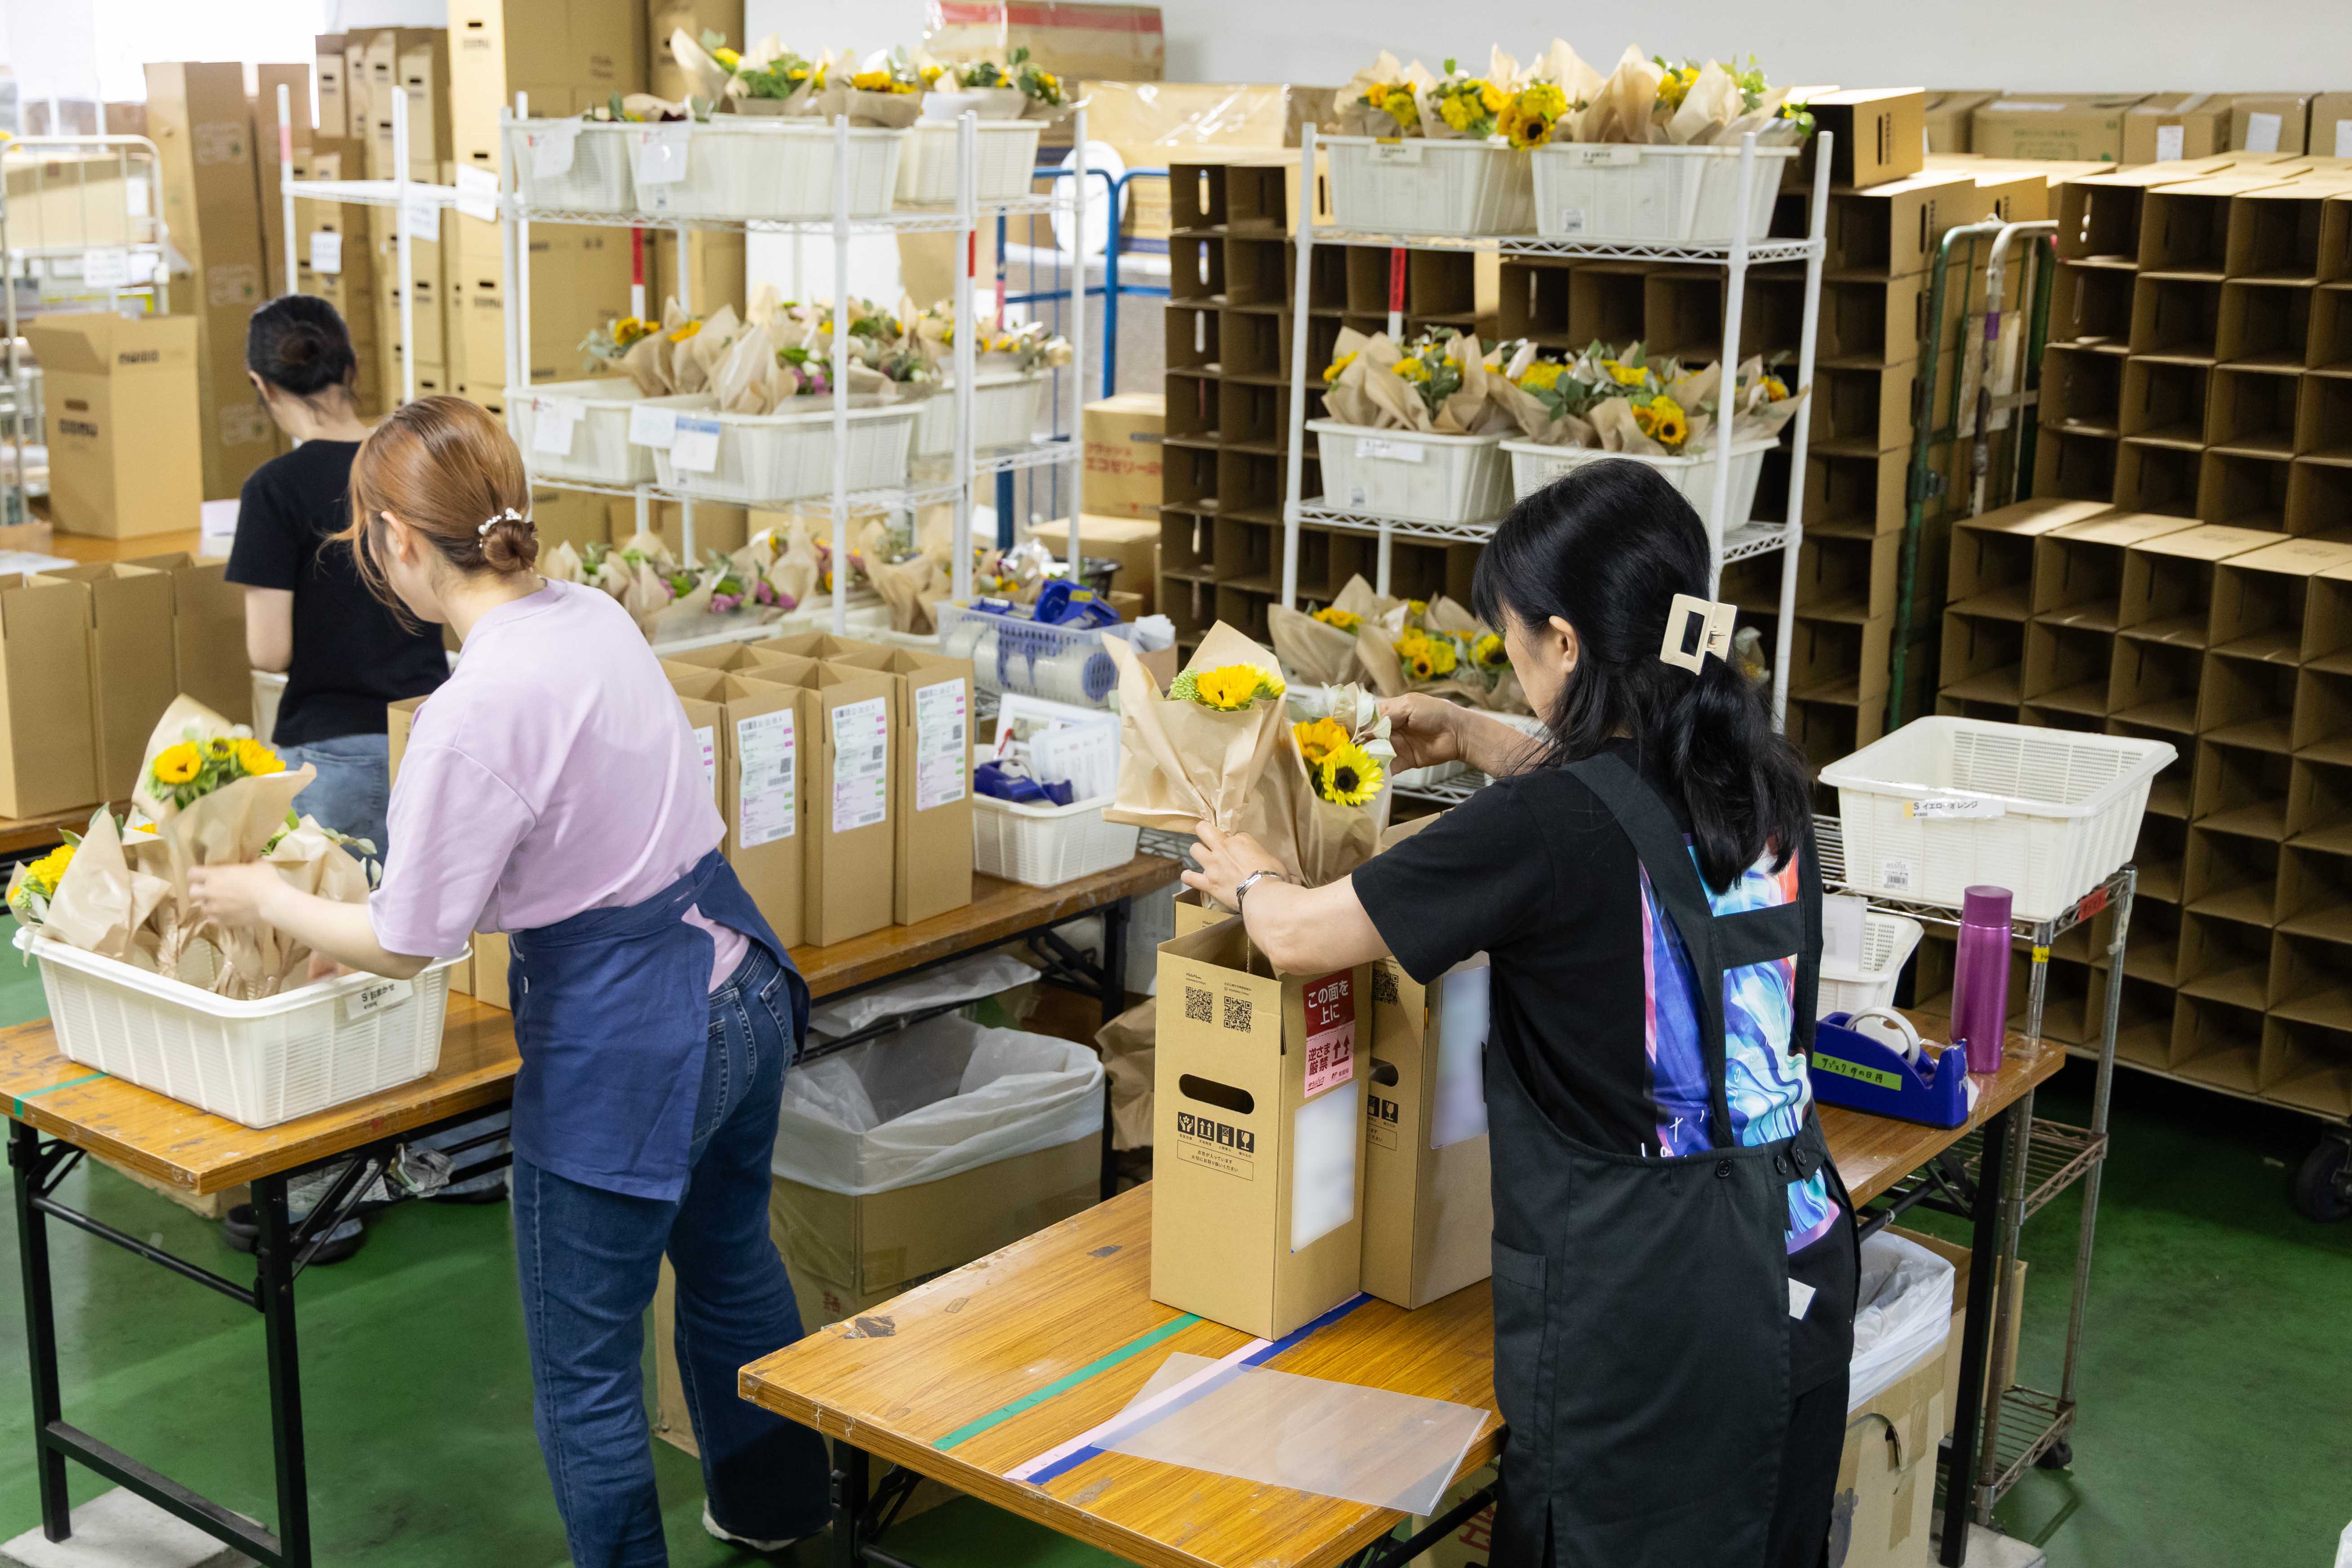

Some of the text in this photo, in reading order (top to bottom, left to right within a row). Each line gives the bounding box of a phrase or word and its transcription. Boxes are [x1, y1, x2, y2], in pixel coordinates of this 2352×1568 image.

[1913, 802, 1920, 810] S
[361, 993, 368, 1002] S
[1308, 980, 1349, 1008] この面を
[1320, 1003, 1340, 1025] 上に
[1308, 1042, 1331, 1062] 逆さま
[1309, 1056, 1329, 1076] 厳禁
[1191, 1154, 1238, 1172] 大切にお取り扱いください
[1197, 1150, 1233, 1164] お花が入っています
